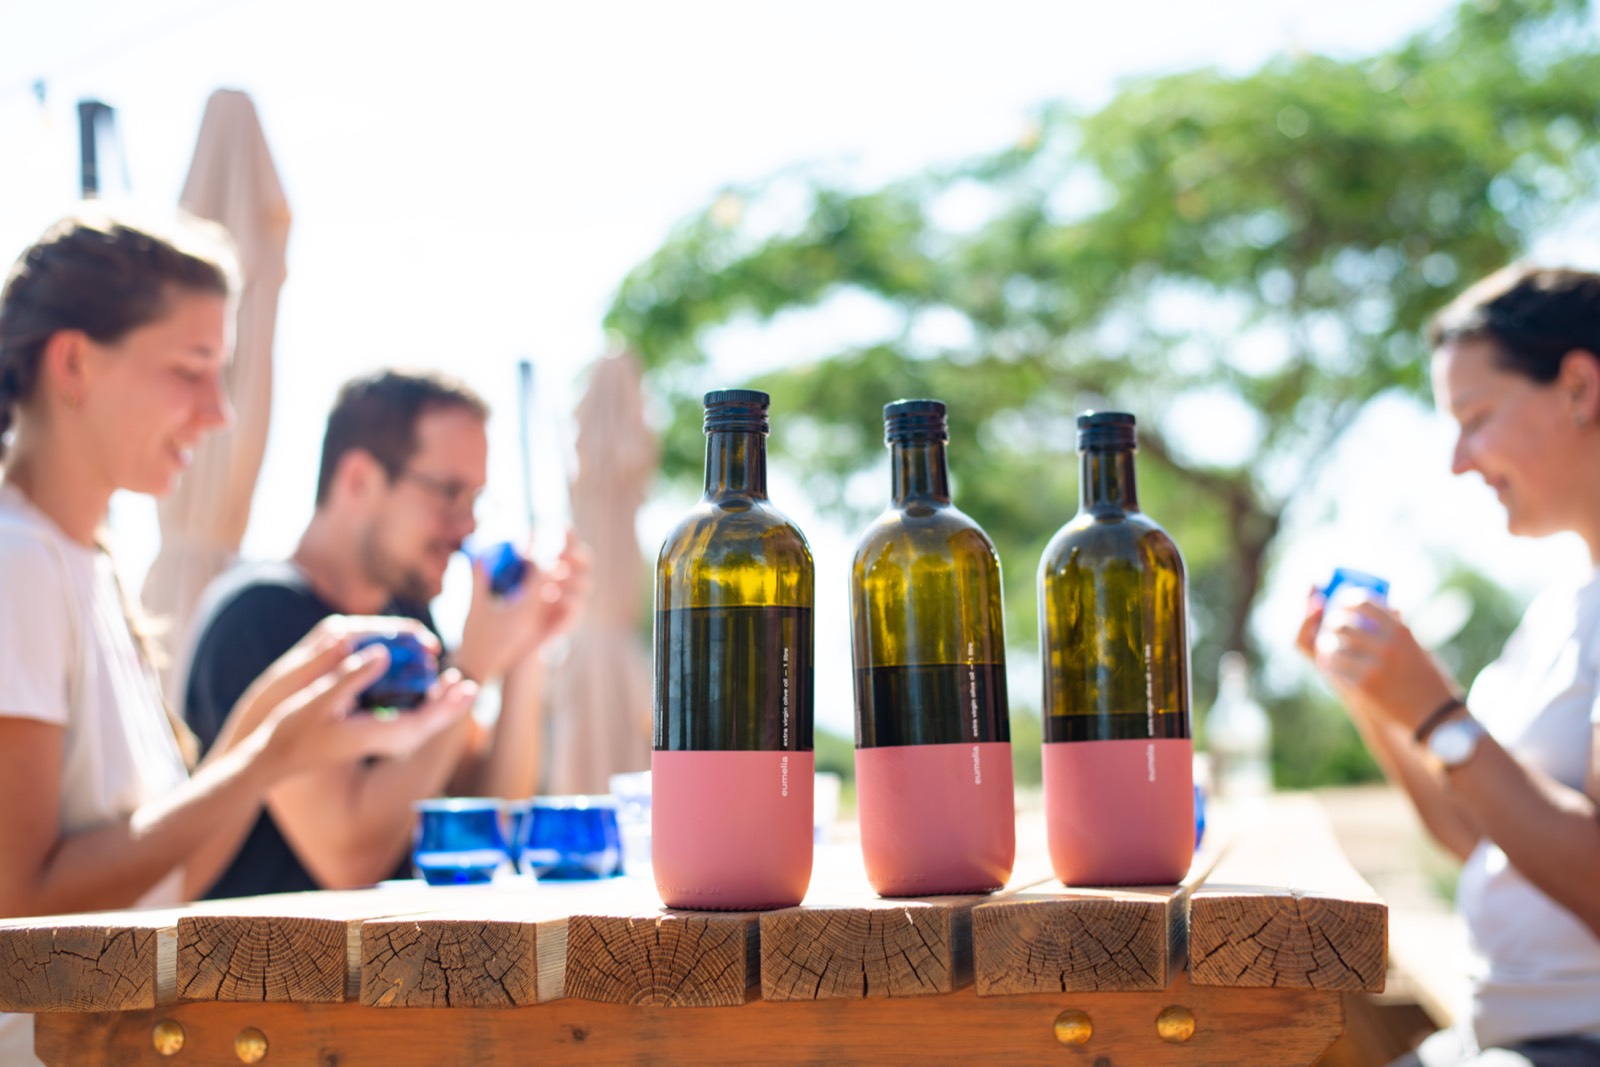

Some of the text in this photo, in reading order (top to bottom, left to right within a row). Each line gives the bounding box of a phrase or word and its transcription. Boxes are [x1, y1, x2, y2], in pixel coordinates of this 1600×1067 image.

[780, 756, 788, 797] eumelia
[972, 746, 982, 785] eumelia
[1146, 744, 1156, 783] eumelia
